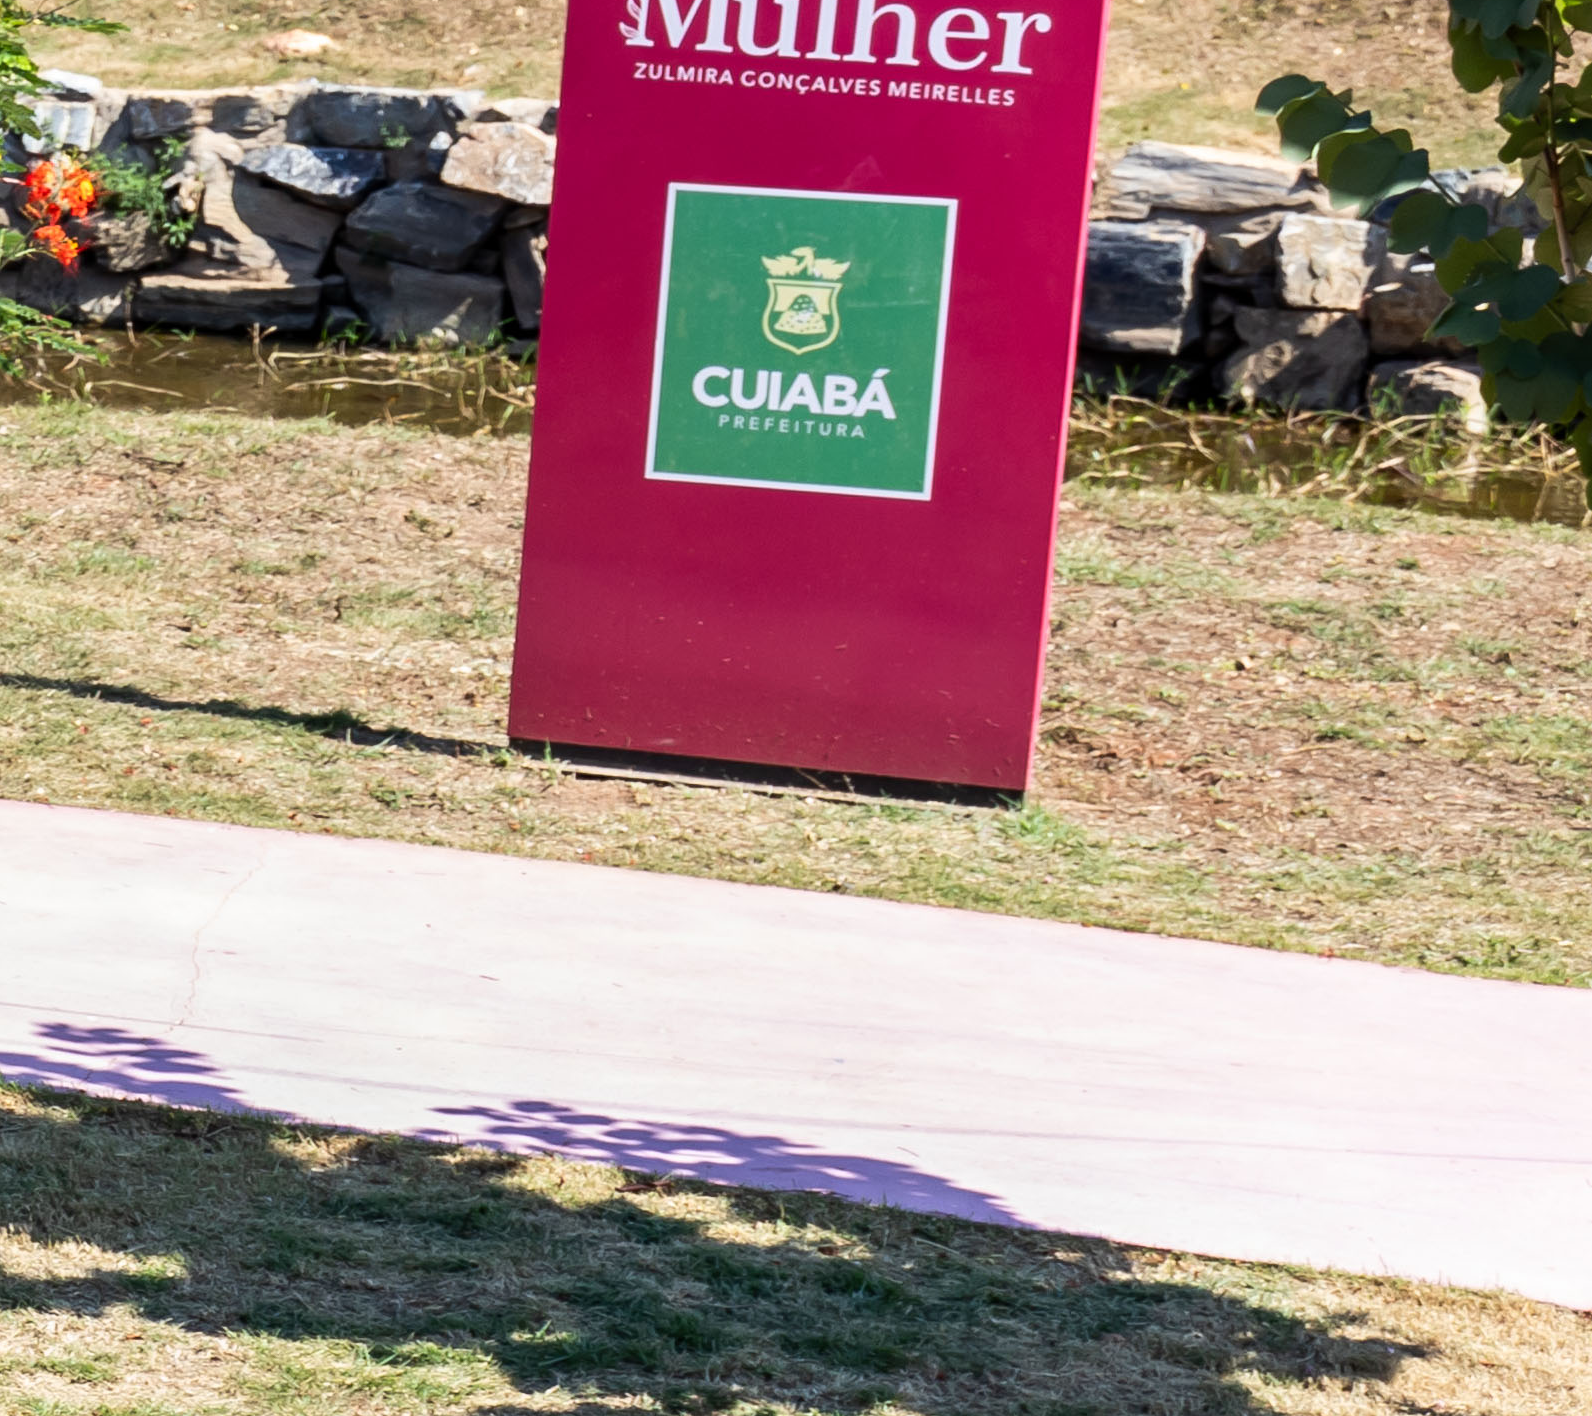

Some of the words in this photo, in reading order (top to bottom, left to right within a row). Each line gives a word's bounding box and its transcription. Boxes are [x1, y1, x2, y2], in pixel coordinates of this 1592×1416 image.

[633, 62, 734, 86] ZULMIRA
[740, 70, 882, 97] GONÇALVES
[888, 81, 1016, 107] MEIRELLES
[691, 365, 897, 420] CUIABÁ
[718, 414, 866, 439] PREFEITURA
